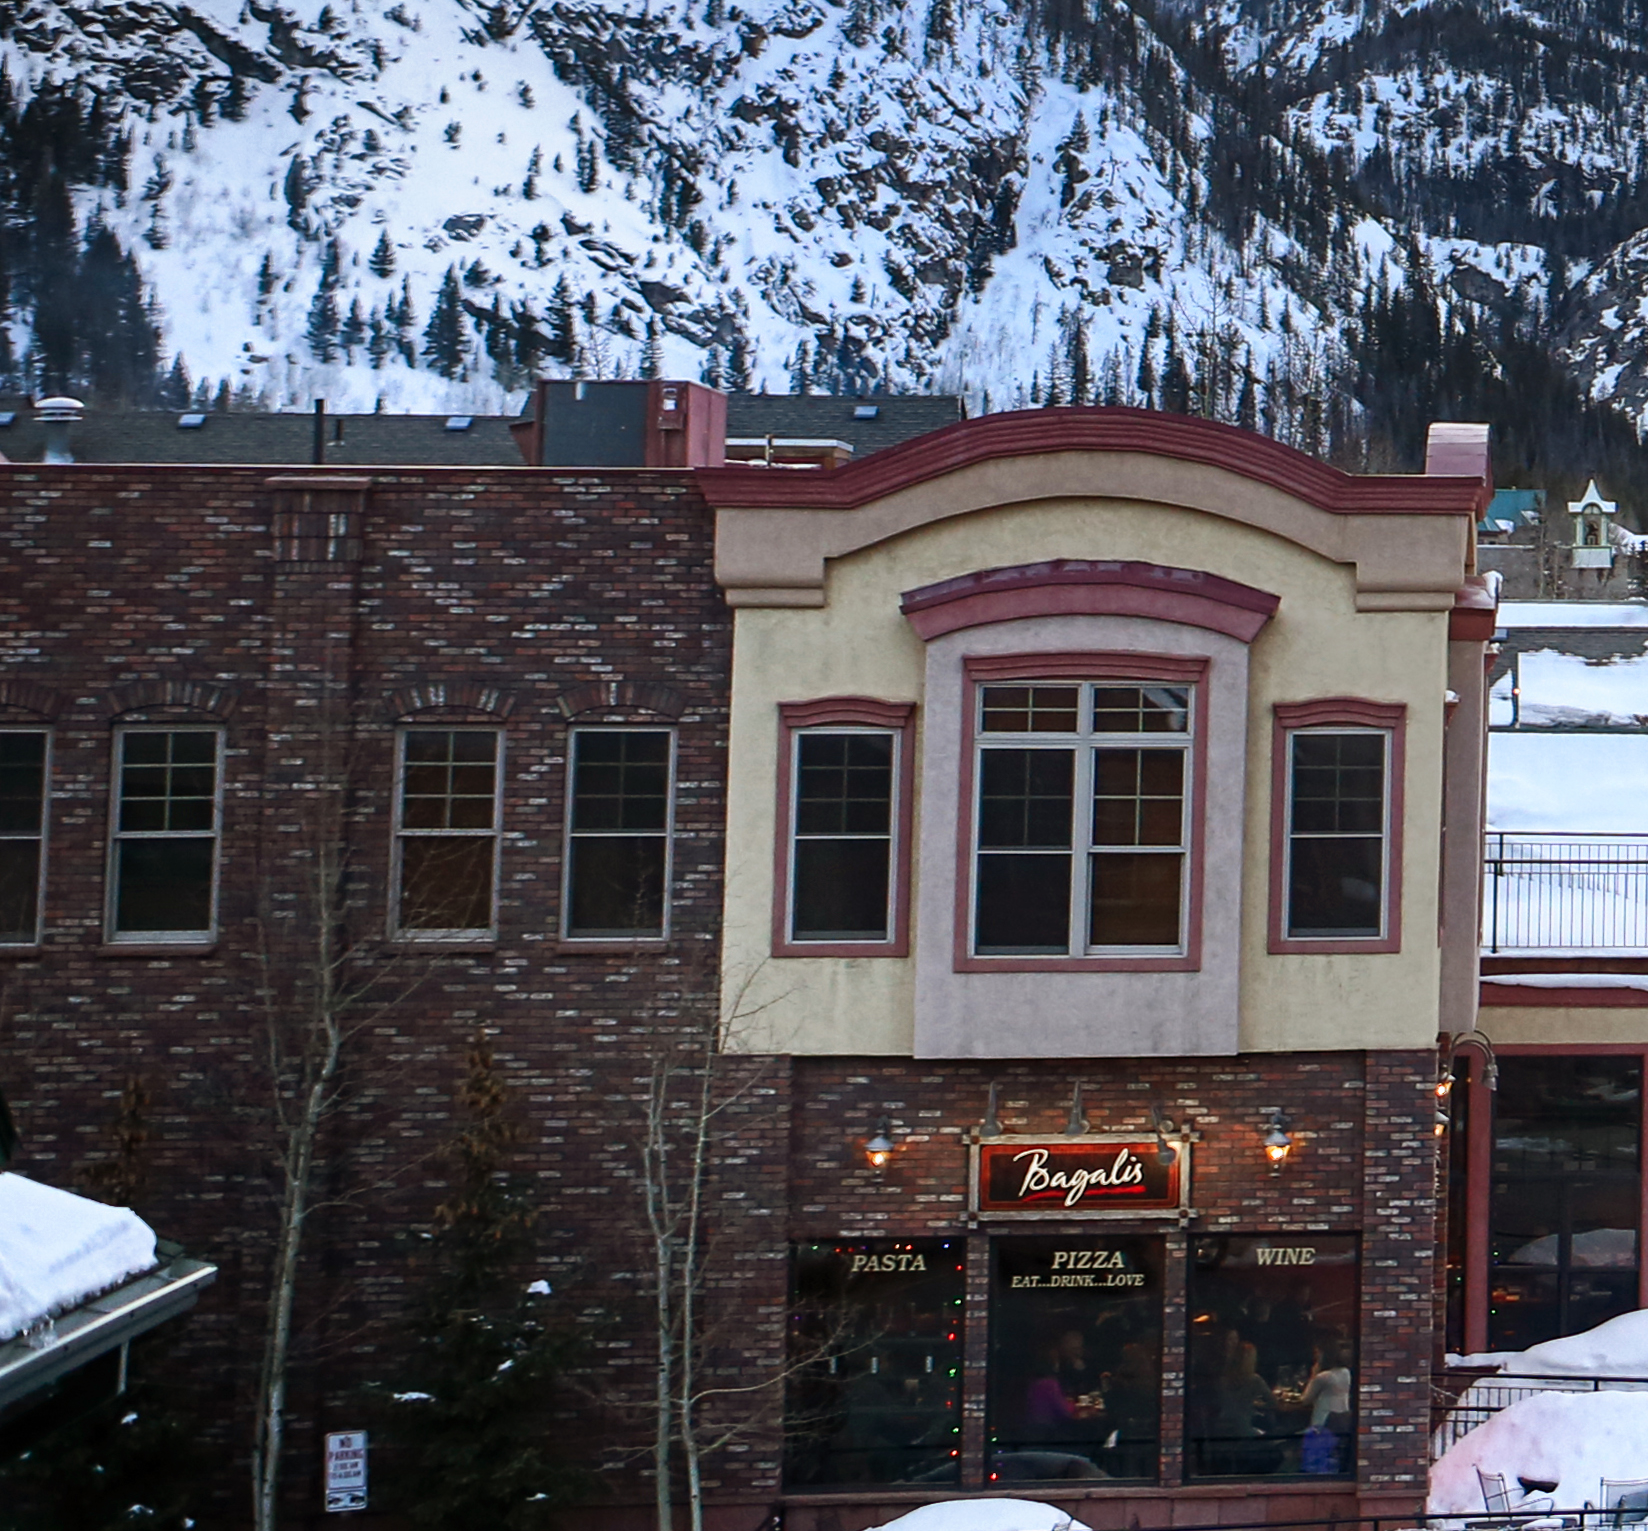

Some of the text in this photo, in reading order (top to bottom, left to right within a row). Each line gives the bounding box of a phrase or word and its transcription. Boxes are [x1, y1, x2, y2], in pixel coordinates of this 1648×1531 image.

[1012, 1148, 1144, 1207] Bagalis
[851, 1254, 927, 1272] PASTA
[1051, 1250, 1125, 1269] PIZZA
[1256, 1247, 1316, 1266] WINE
